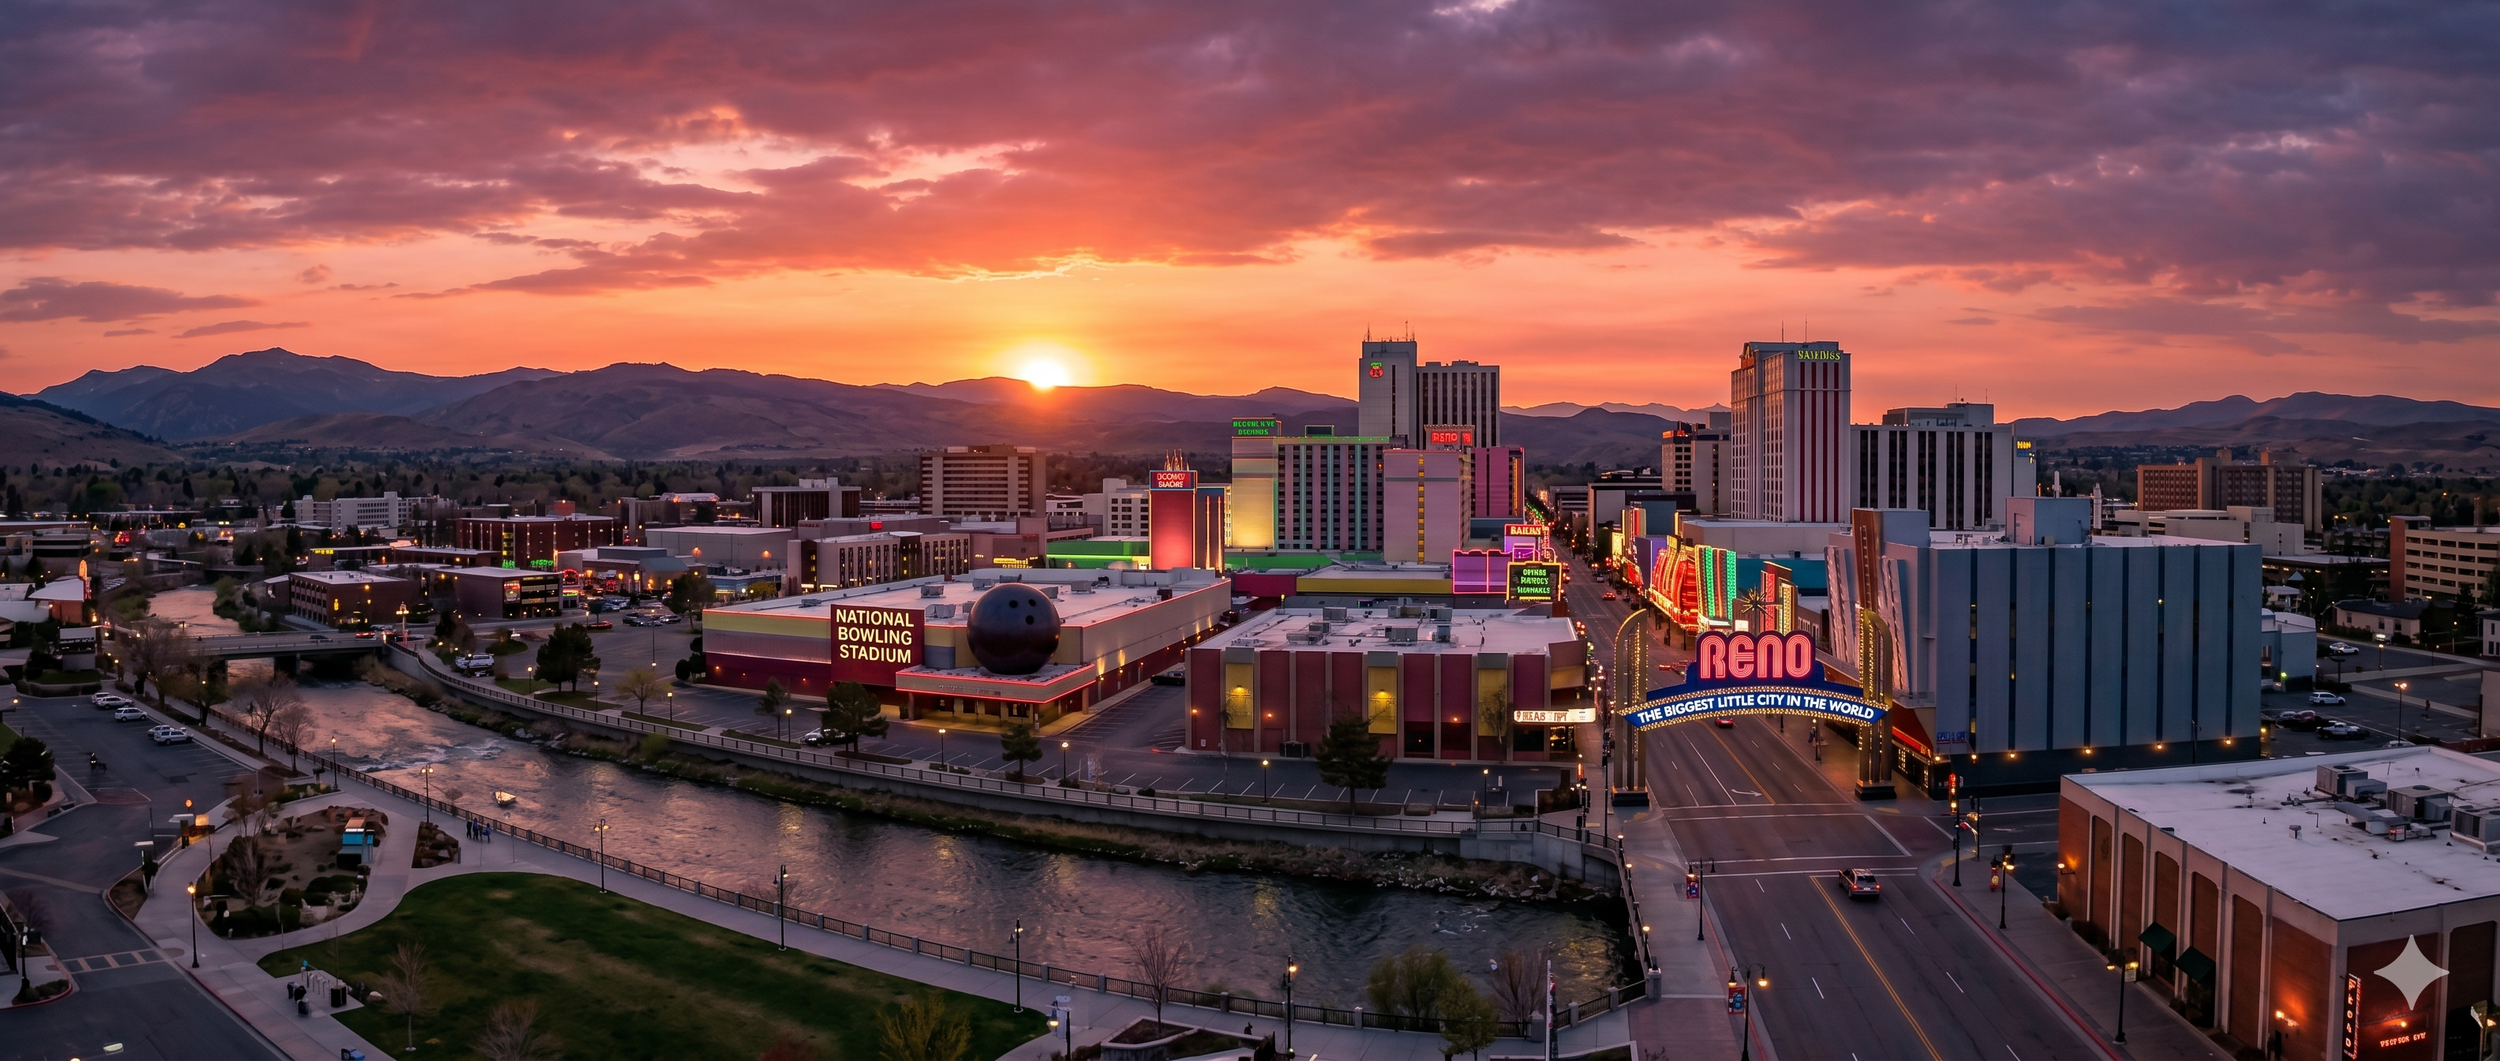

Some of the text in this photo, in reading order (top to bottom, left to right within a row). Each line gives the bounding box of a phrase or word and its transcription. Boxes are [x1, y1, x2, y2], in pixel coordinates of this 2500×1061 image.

[836, 608, 915, 628] NATIONAL
[838, 626, 912, 646] BOWLING
[839, 644, 911, 664] STADIUM
[1700, 634, 1812, 679] RENO
[1637, 694, 1875, 724] THE BIGGEST LITTLE CITY IN THE WORLD
